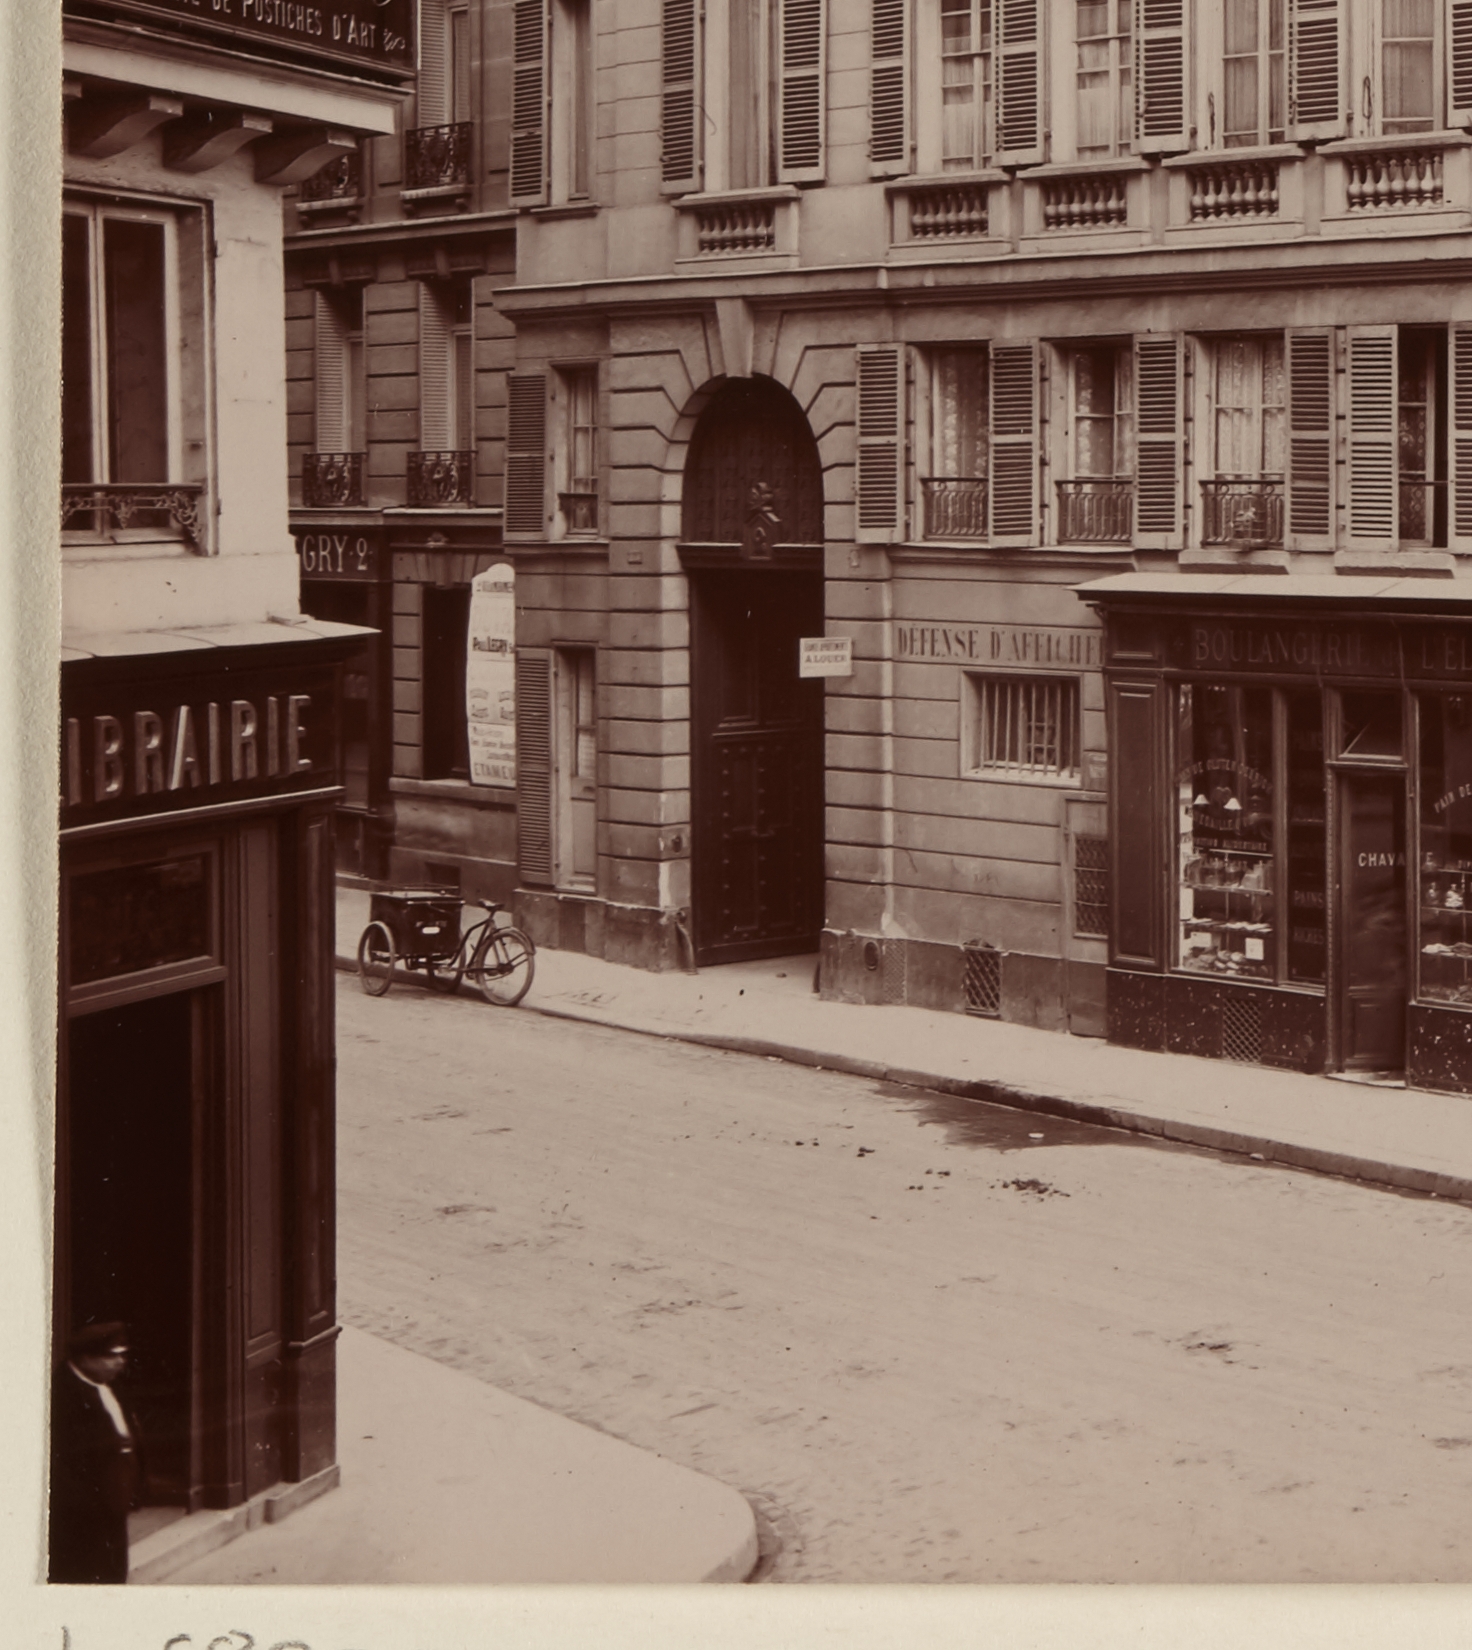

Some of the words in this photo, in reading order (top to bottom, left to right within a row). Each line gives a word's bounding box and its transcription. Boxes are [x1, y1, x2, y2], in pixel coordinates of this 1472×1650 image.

[1194, 627, 1371, 669] BOULANGERIE
[66, 694, 313, 807] IBRAIRIE
[1458, 783, 1472, 799] DE
